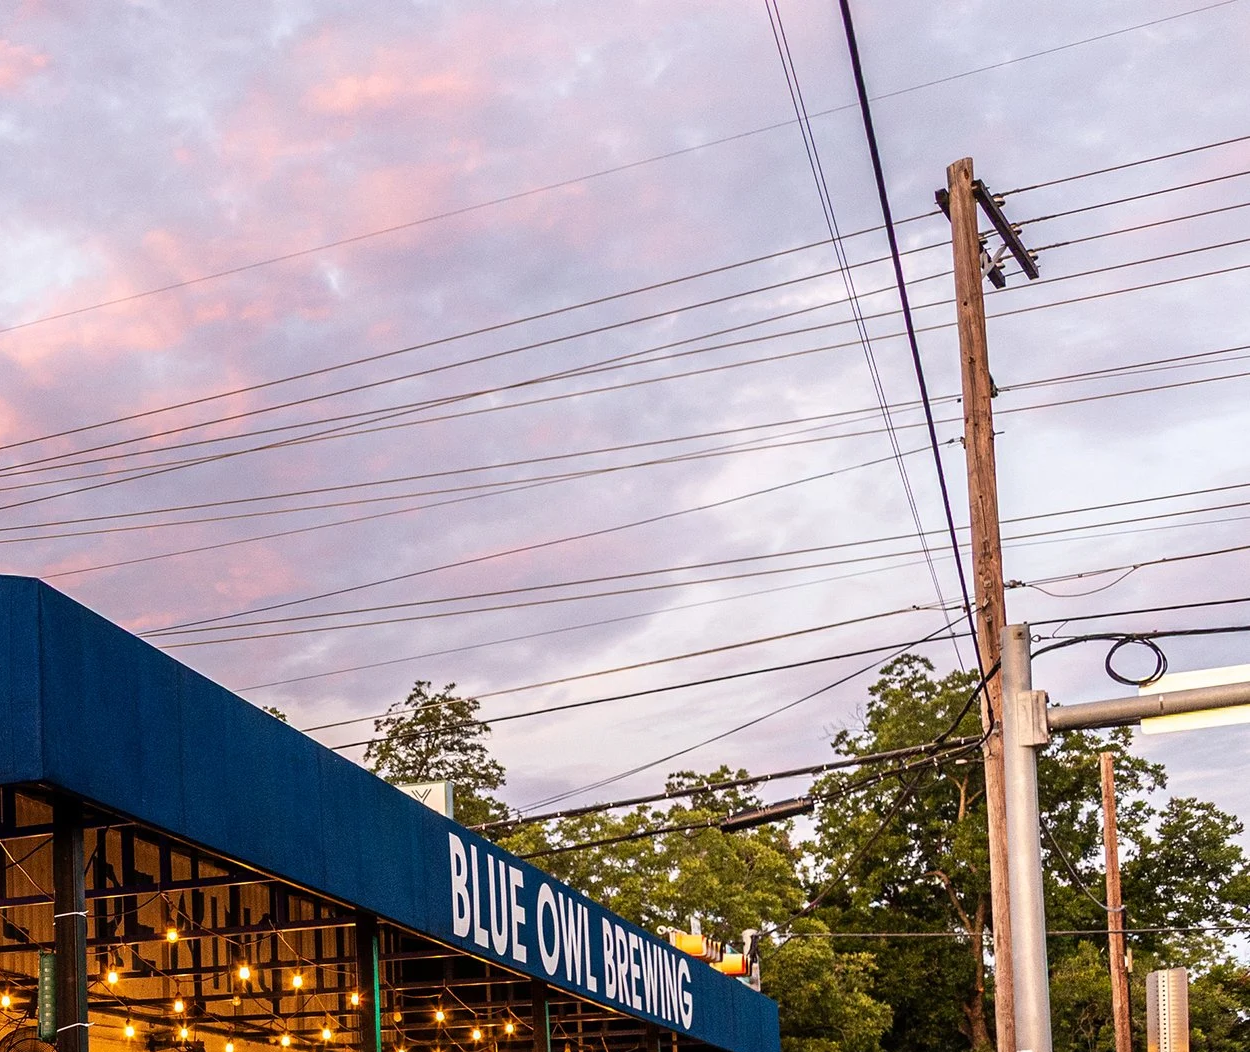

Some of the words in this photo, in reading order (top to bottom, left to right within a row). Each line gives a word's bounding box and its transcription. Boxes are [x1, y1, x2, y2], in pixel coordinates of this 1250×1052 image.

[449, 832, 527, 964] BLUE
[537, 882, 598, 993] OWL
[602, 917, 693, 1030] BREWING
